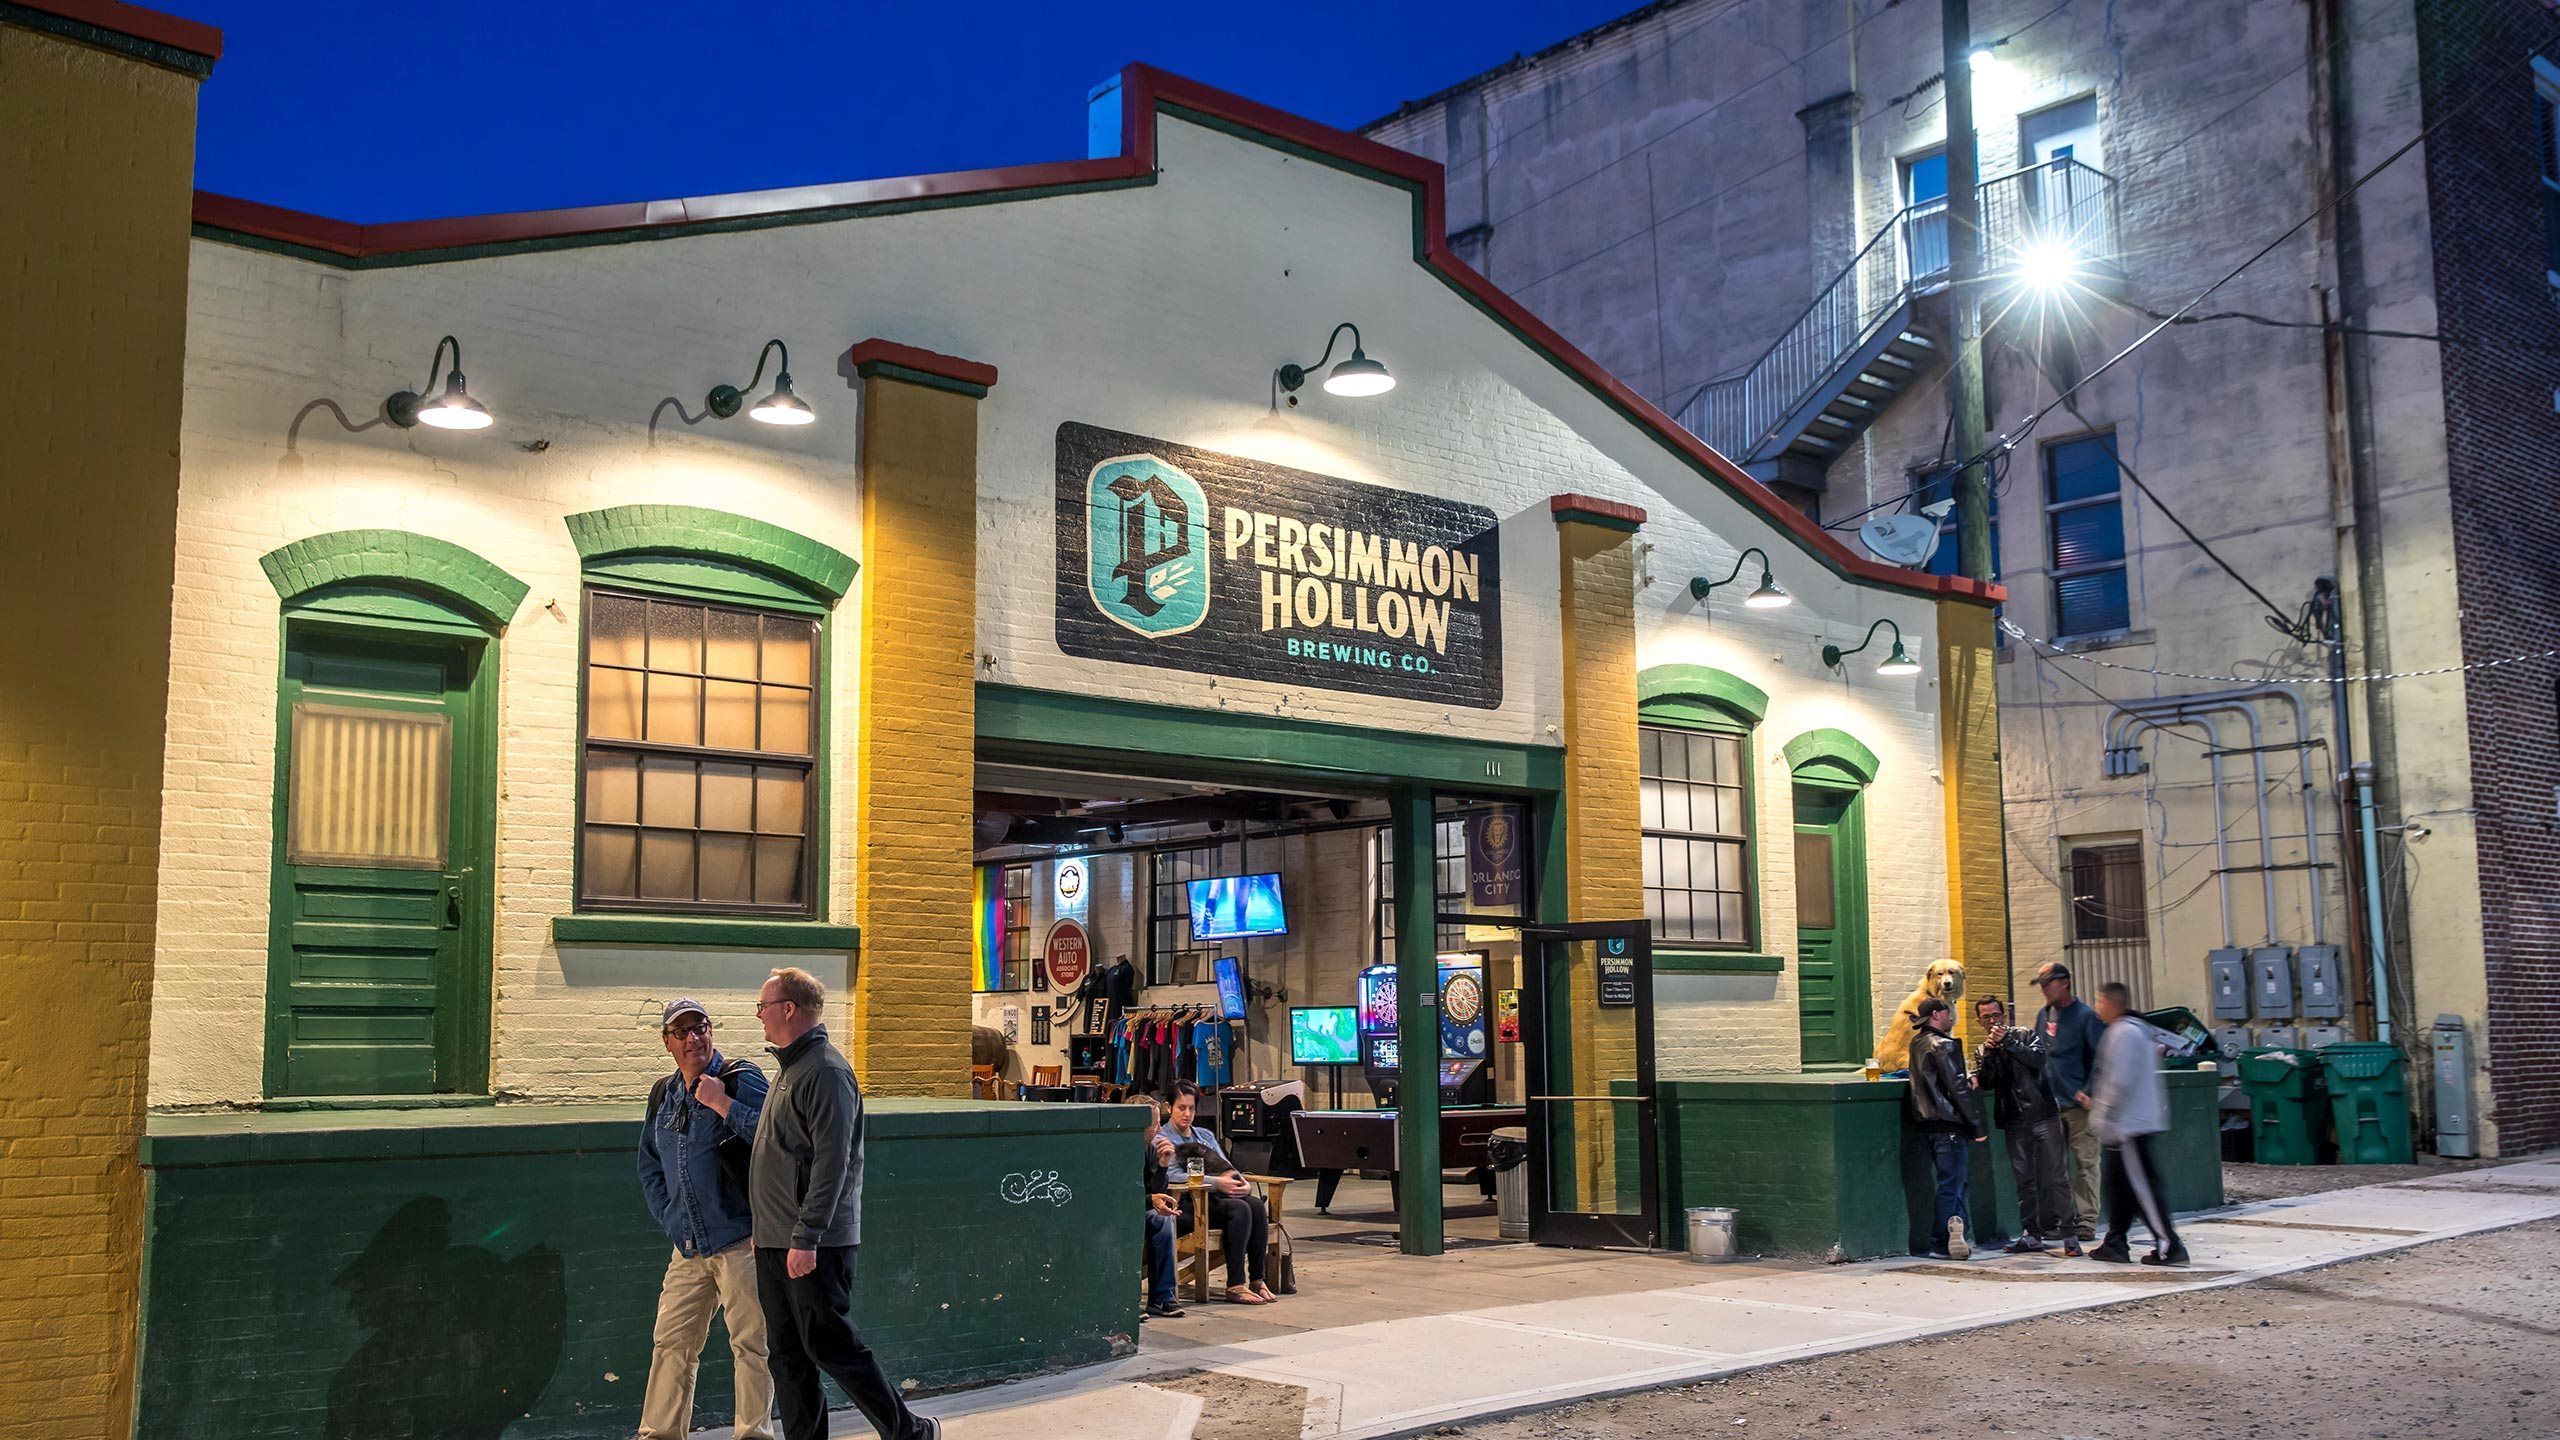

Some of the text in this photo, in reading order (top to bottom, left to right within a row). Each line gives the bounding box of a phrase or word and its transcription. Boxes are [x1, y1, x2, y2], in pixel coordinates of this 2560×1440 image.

[1224, 505, 1480, 603] PERSIMMON
[1261, 570, 1451, 656] HOLLOW
[1287, 637, 1438, 675] BREWING CO.
[1472, 868, 1520, 883] ORLANDO
[1484, 883, 1510, 895] CITY
[1052, 937, 1082, 950] WESTERN
[1058, 952, 1078, 964] AUTO
[1600, 958, 1634, 966] PERSIMMON
[1604, 966, 1630, 974] HOLLOW
